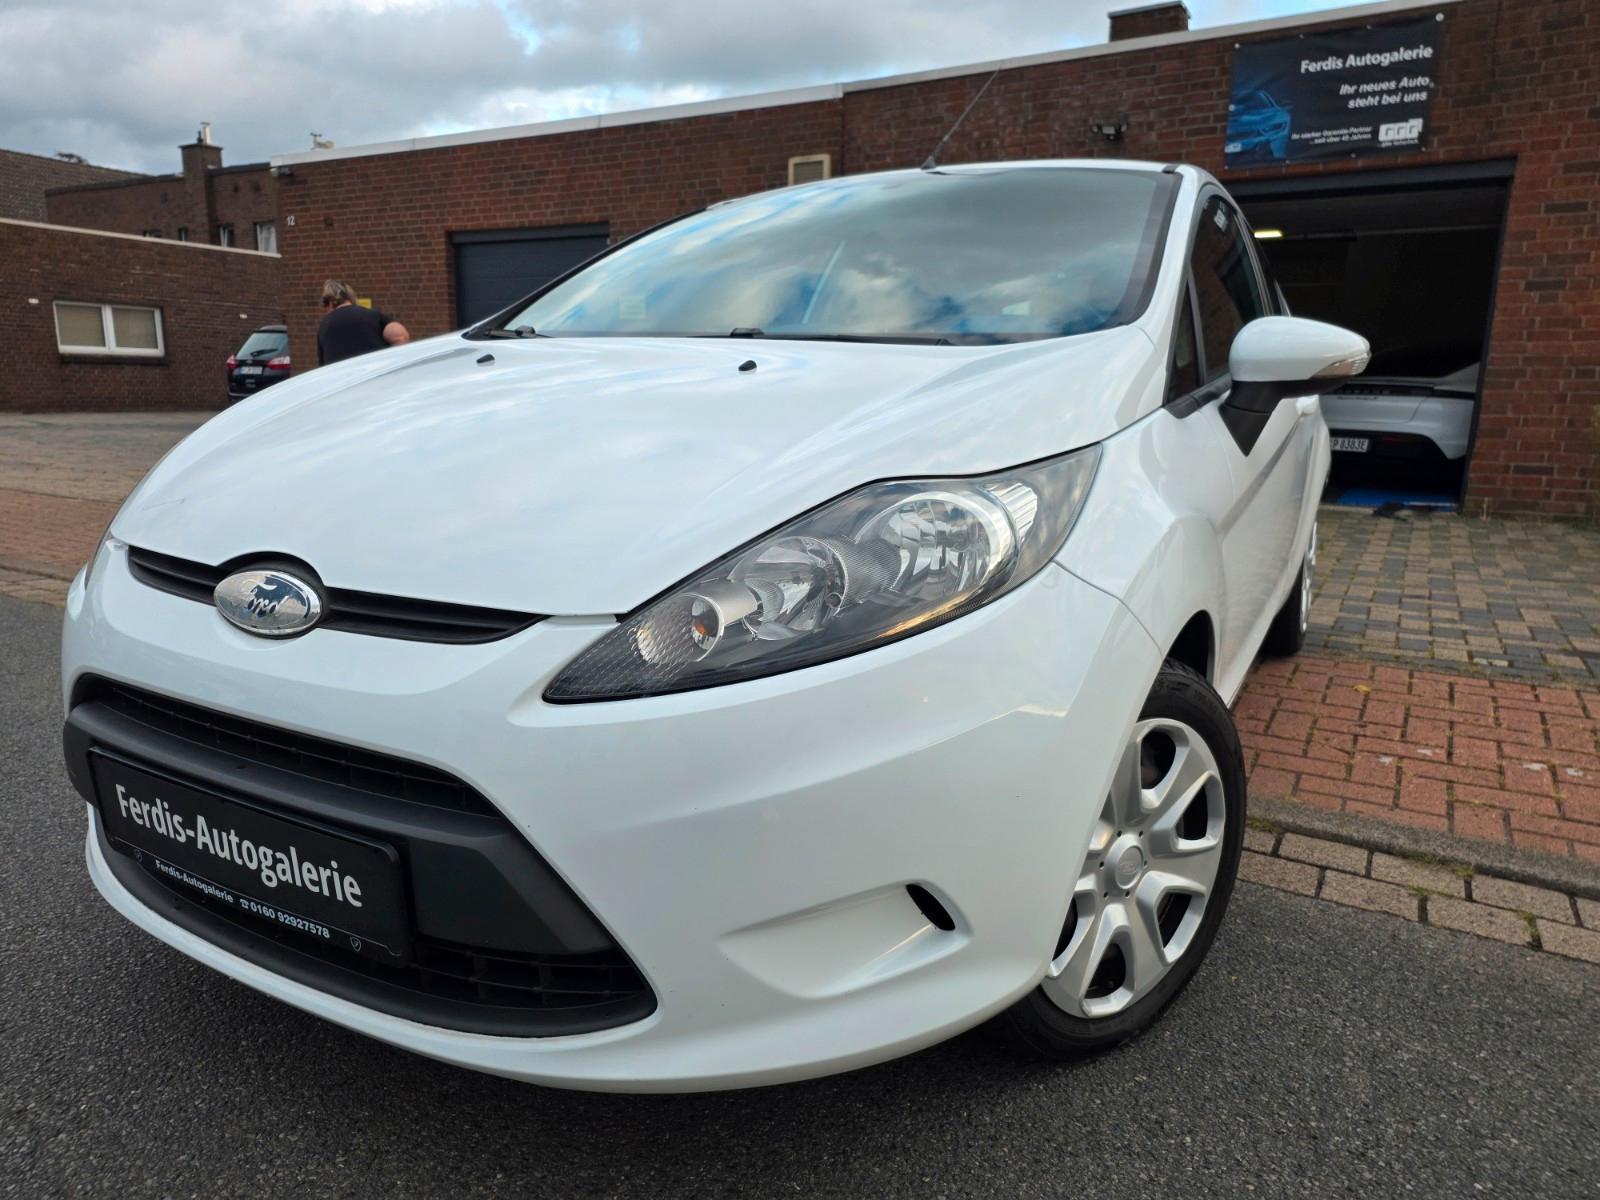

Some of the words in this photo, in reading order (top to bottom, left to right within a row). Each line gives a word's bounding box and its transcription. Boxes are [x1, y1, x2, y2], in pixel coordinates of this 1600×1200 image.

[1300, 56, 1343, 74] Ferdis
[1345, 44, 1434, 68] Autogalerie
[1339, 84, 1358, 96] Ihr
[1358, 81, 1396, 94] neues
[1398, 75, 1431, 90] Auto
[1347, 93, 1380, 109] steht
[1381, 91, 1400, 106] bei
[1402, 90, 1428, 103] uns
[114, 783, 364, 908] Ferdis-Autogalerie
[155, 859, 234, 904] Ferdis-Autogalerie
[250, 901, 276, 919] 0160
[277, 911, 331, 939] 92927578
